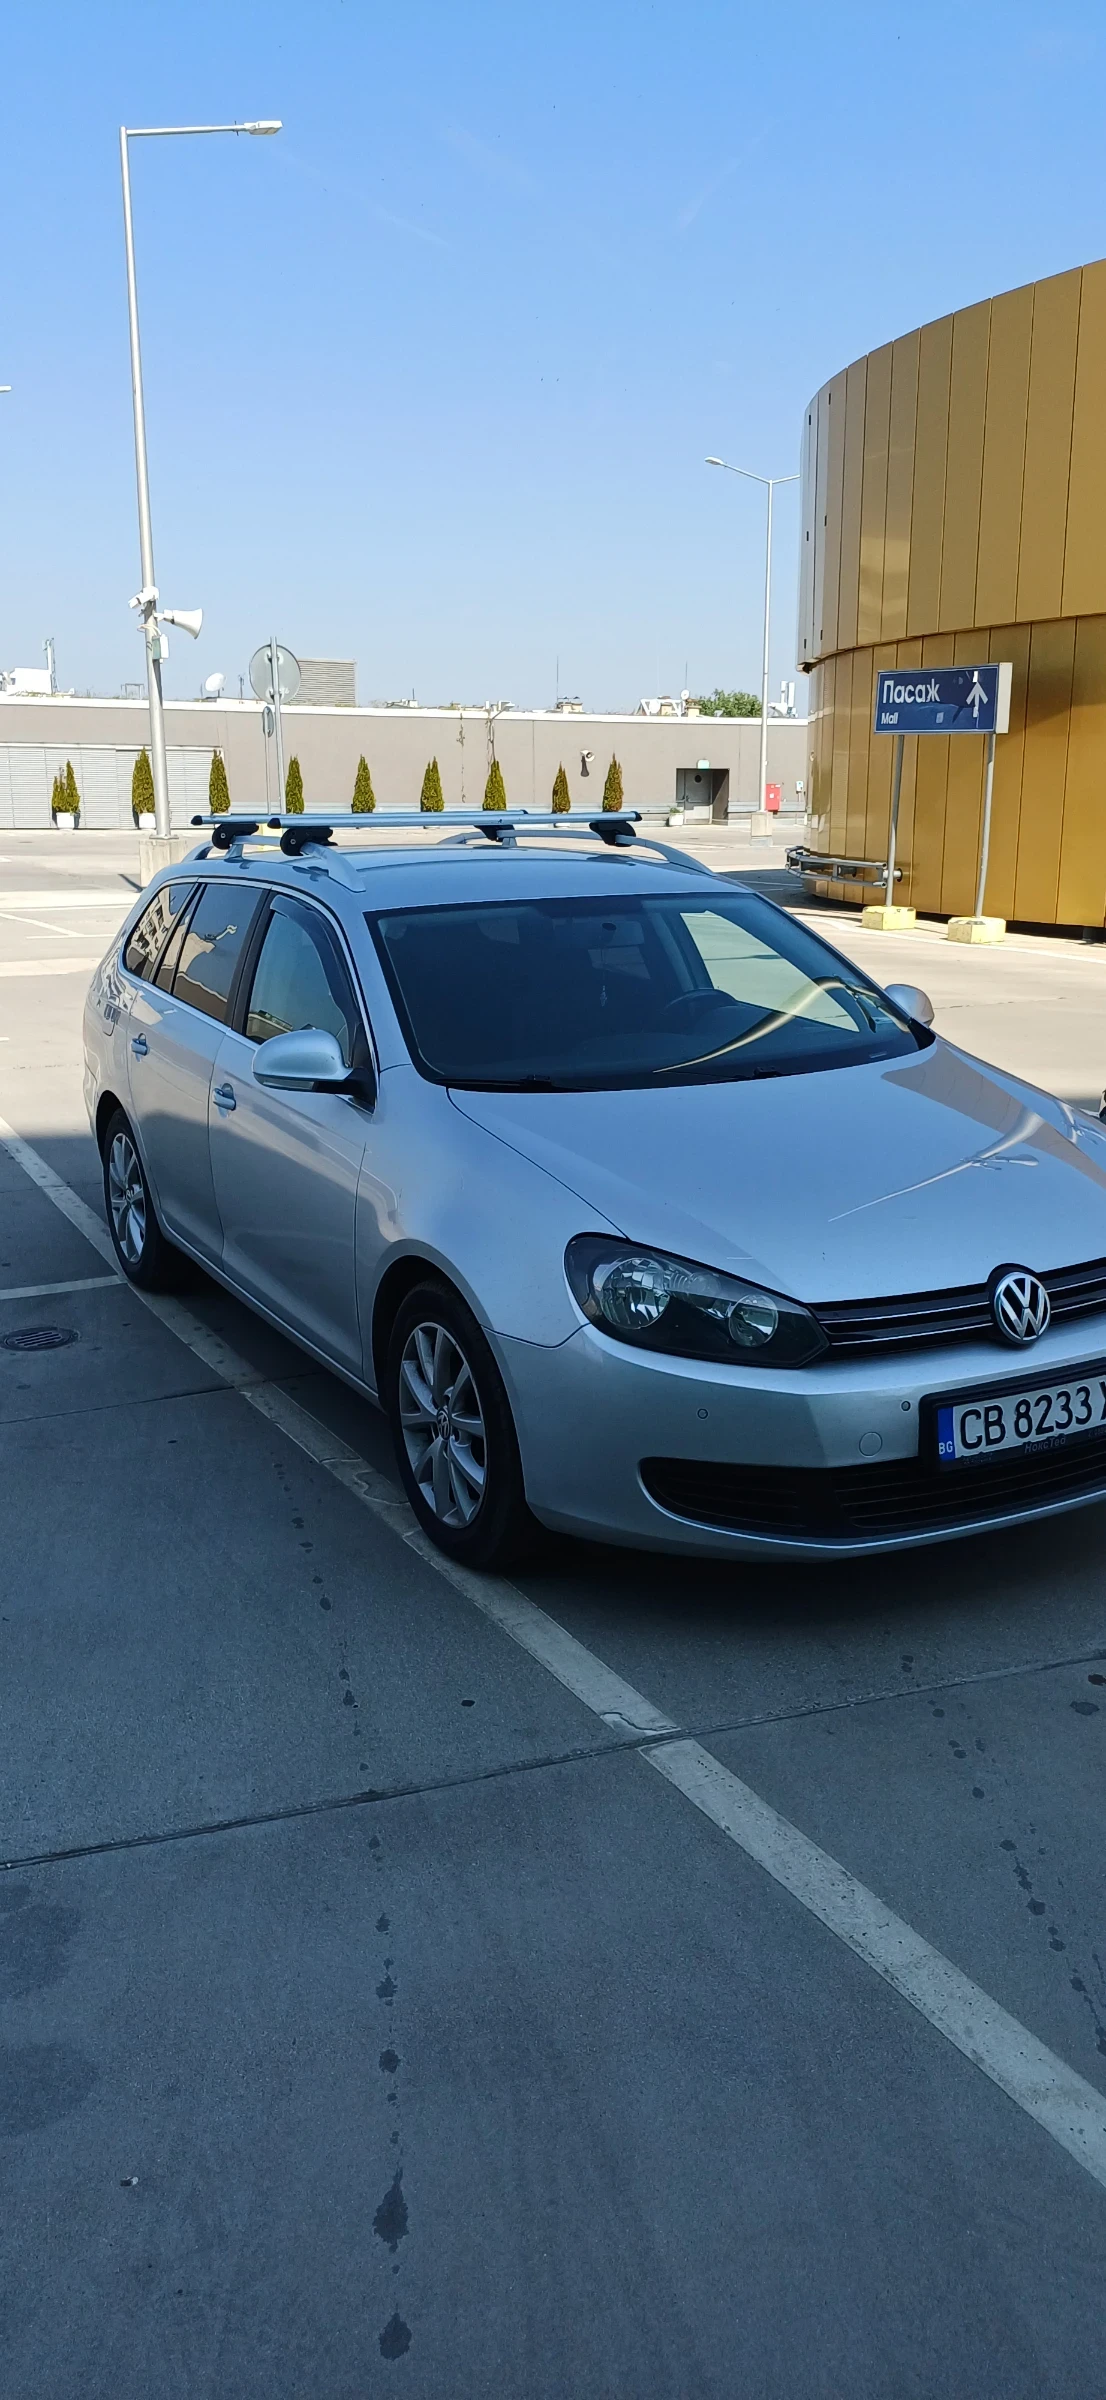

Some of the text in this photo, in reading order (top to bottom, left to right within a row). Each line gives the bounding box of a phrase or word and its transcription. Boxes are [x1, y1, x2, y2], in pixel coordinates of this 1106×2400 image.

[883, 678, 940, 703] Пасаж
[880, 712, 899, 725] Mall
[959, 1404, 1006, 1450] CB
[1014, 1385, 1093, 1439] 8233
[938, 1440, 953, 1455] BG
